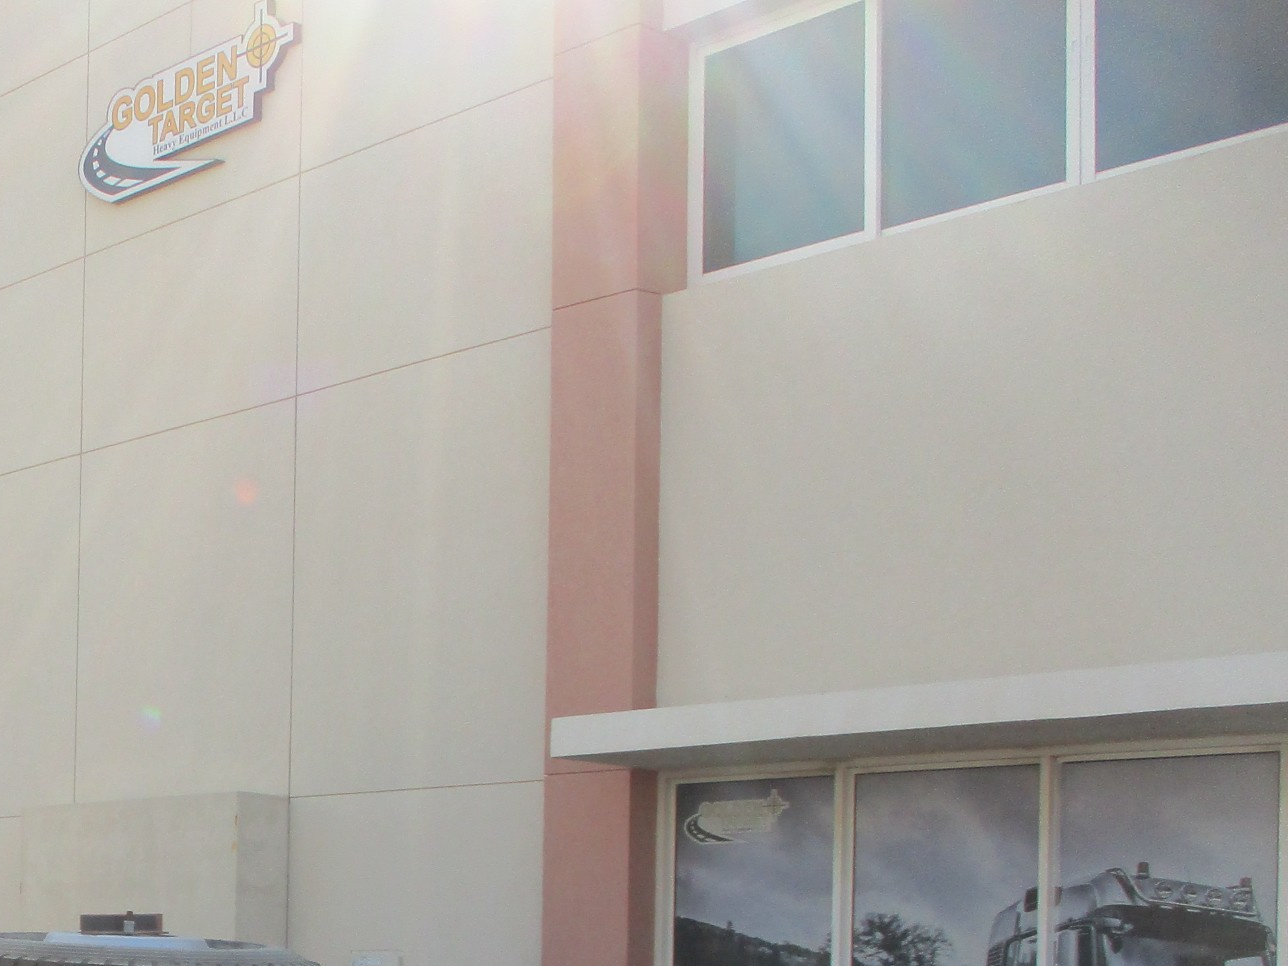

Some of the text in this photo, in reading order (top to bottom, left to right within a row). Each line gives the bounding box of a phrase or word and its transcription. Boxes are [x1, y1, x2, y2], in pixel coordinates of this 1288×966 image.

[112, 45, 238, 131] GOLDEN
[148, 75, 249, 145] TARGET
[152, 140, 176, 156] Heavy
[178, 121, 222, 144] Equipment
